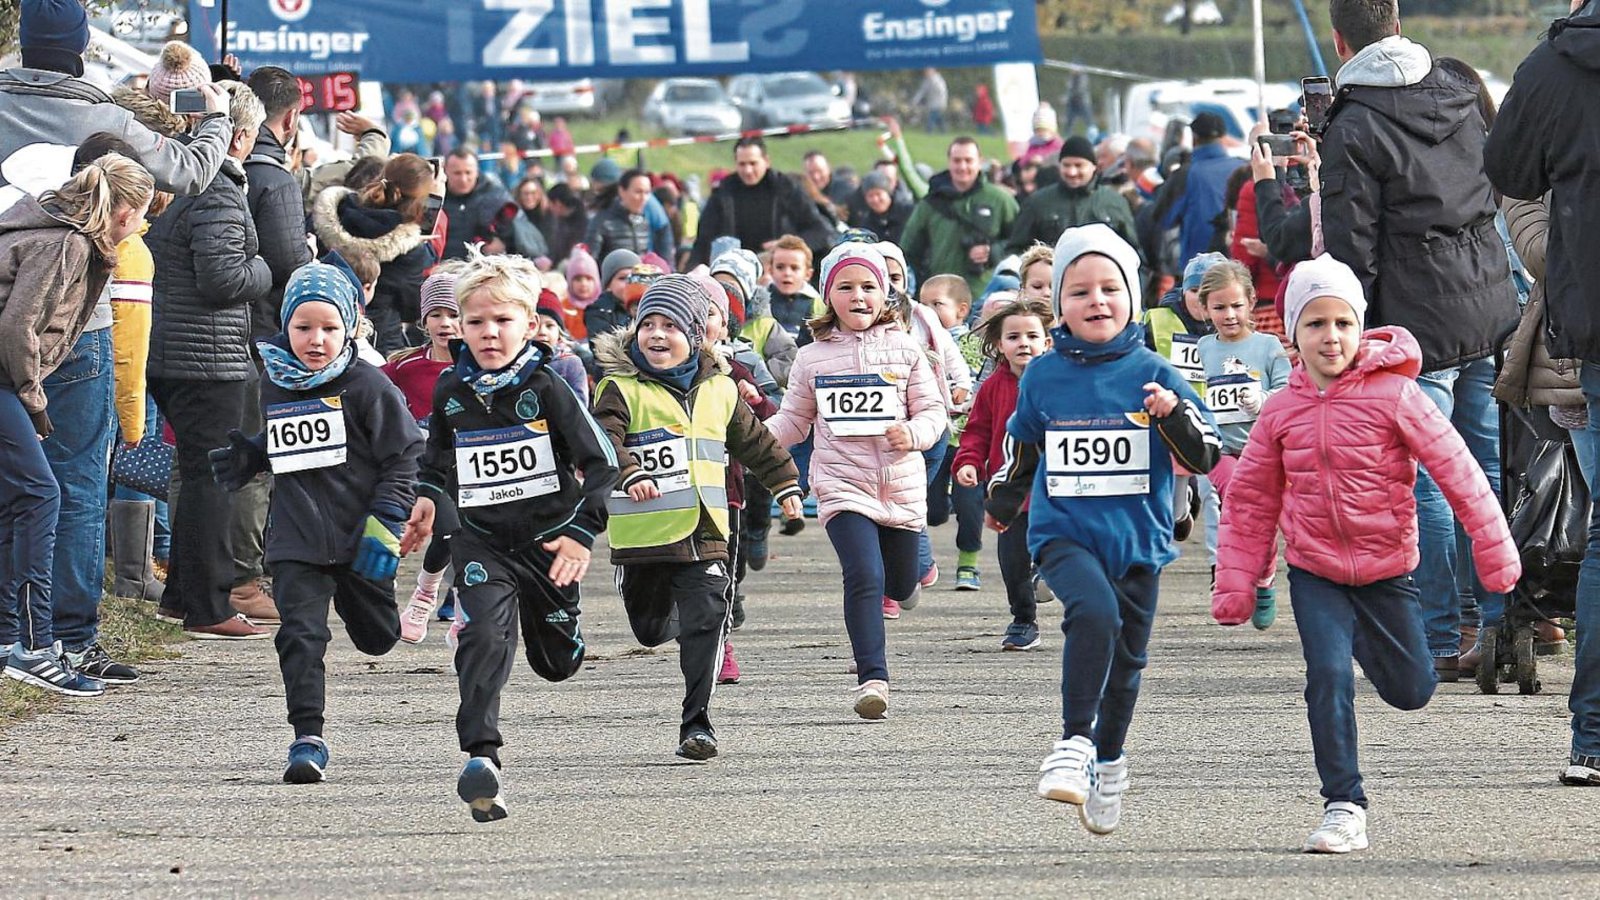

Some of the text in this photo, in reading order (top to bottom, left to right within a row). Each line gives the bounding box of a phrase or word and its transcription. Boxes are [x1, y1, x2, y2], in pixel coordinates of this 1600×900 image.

[215, 21, 370, 60] Ensinger
[483, 0, 749, 67] ZIEL
[862, 10, 1014, 43] Ensinger
[826, 391, 884, 413] 1622
[1210, 386, 1250, 407] 161
[270, 418, 331, 448] 1609
[469, 445, 537, 479] 1550
[1058, 437, 1131, 466] 1590
[489, 486, 524, 501] Jakob
